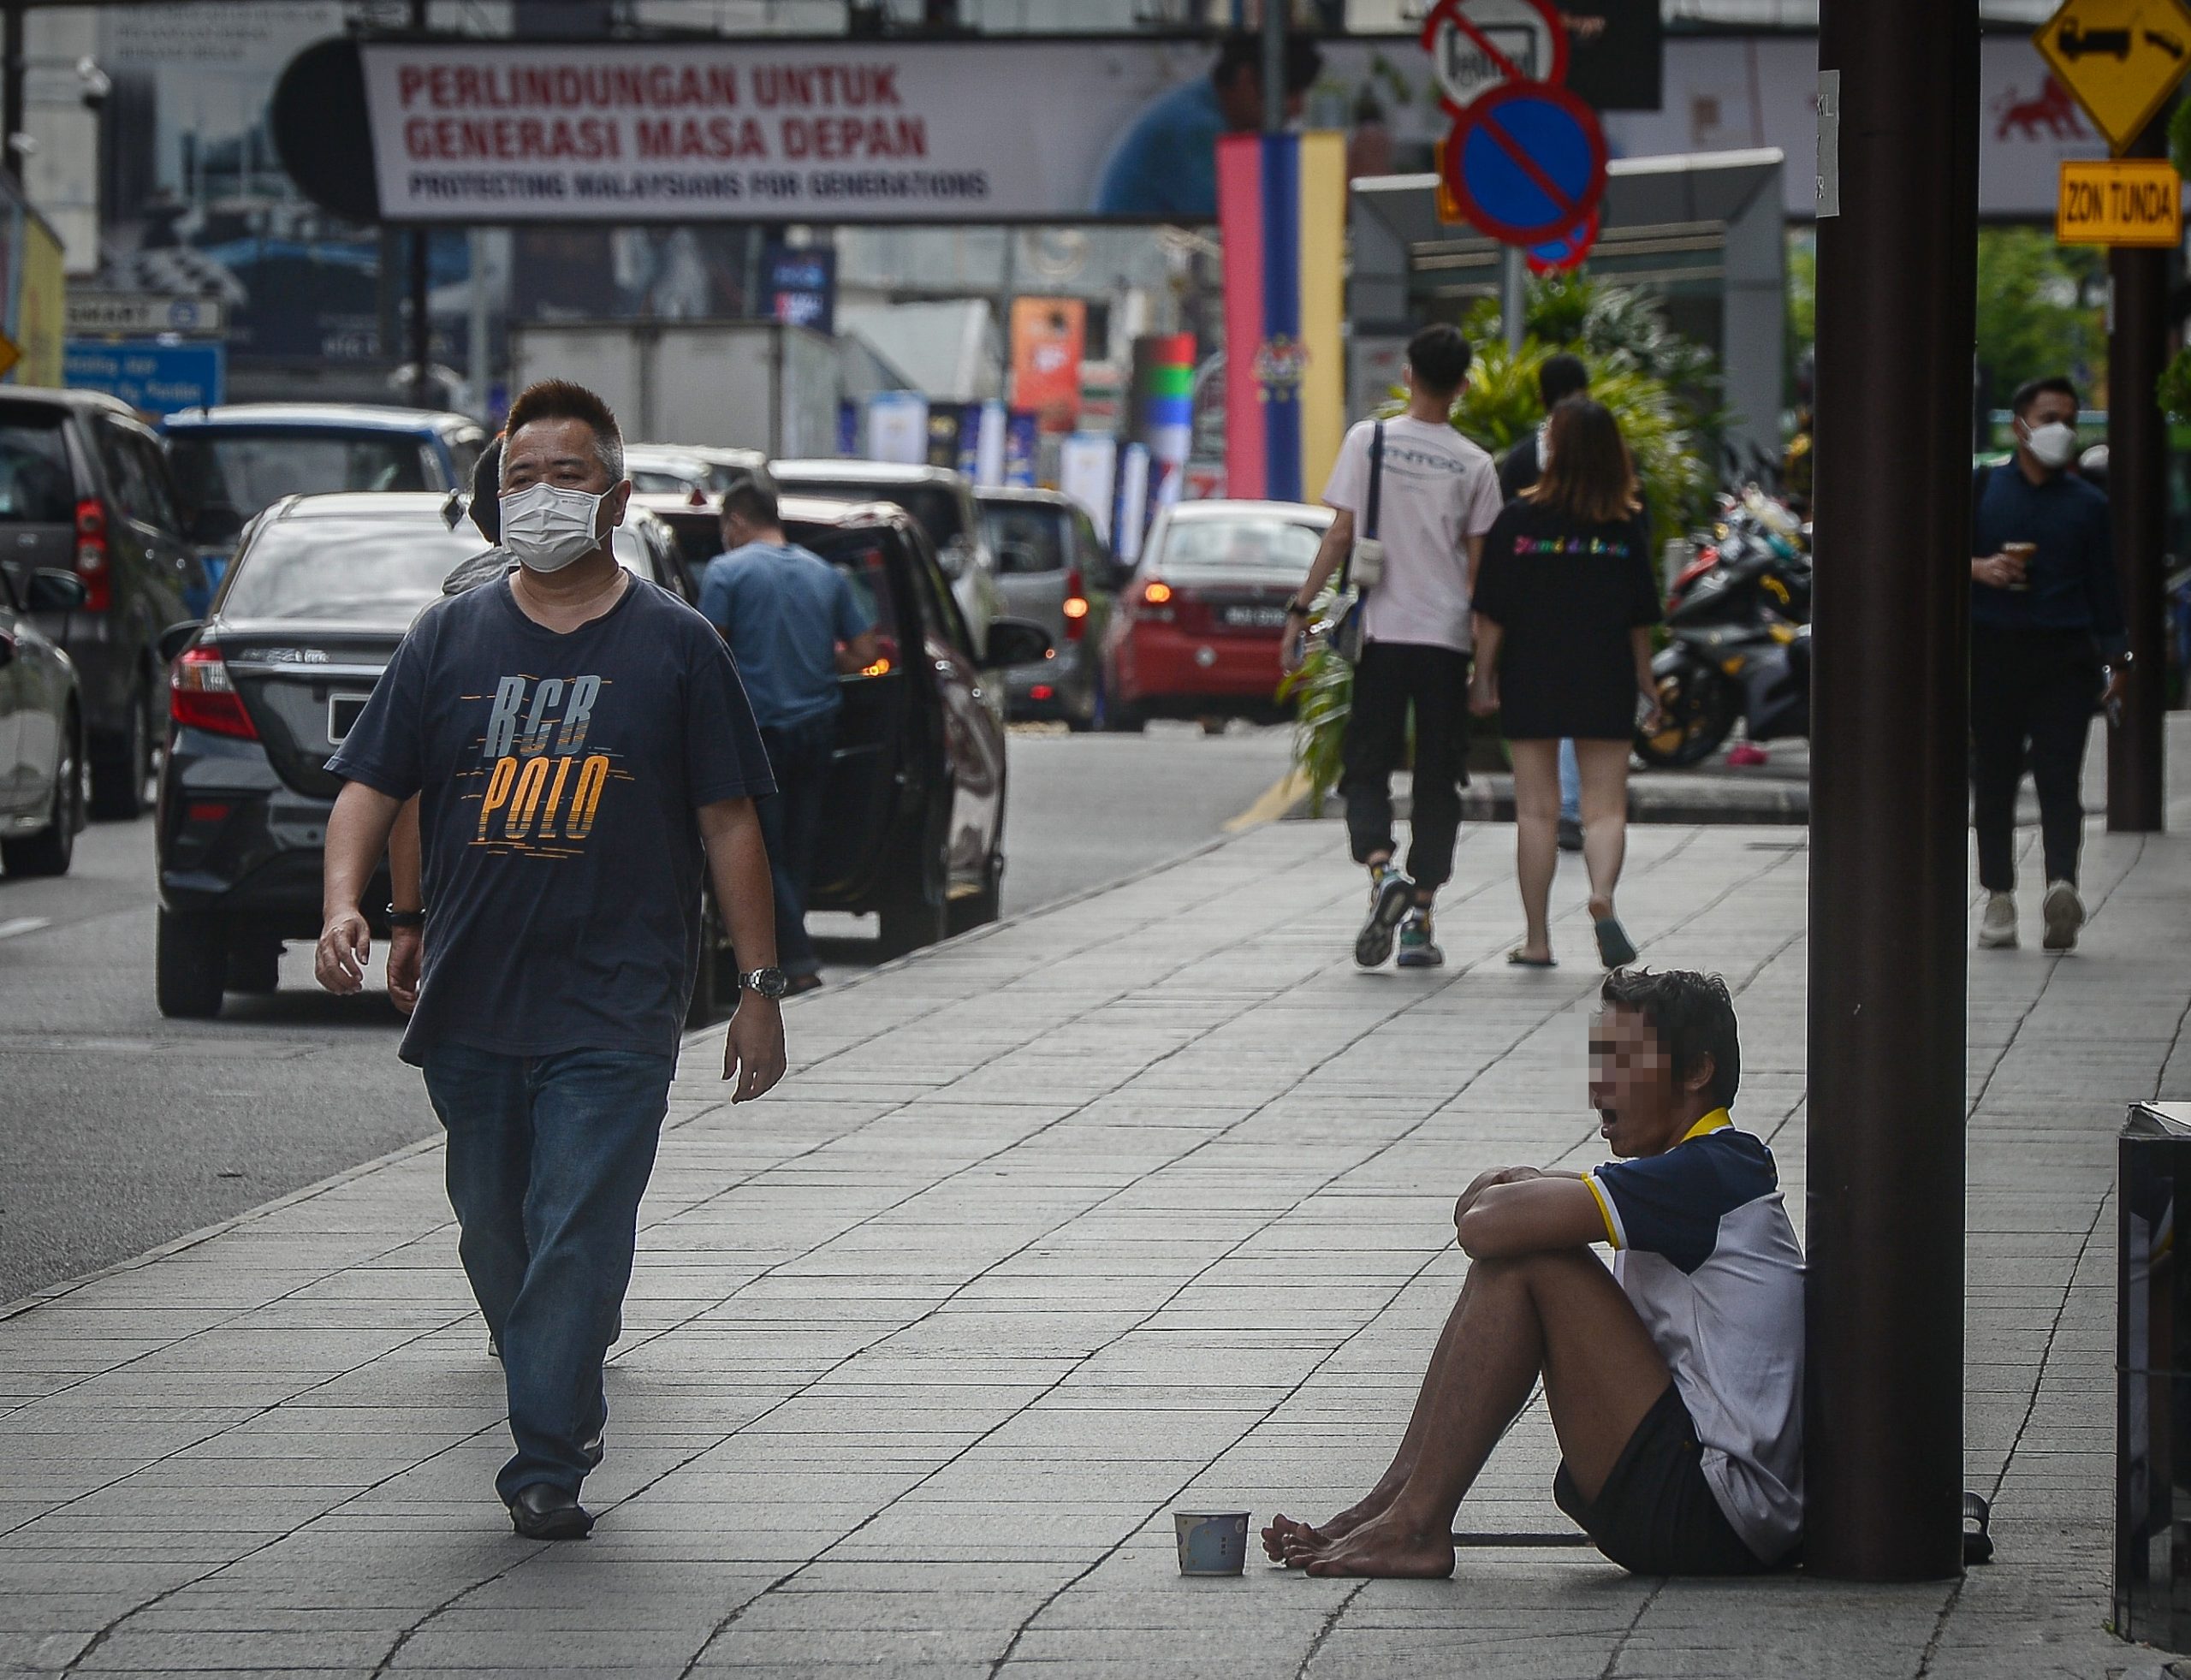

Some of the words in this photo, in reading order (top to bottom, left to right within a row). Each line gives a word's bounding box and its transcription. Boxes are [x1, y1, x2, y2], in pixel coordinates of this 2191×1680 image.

[400, 63, 737, 110] PERLINDUNGAN
[752, 62, 902, 108] UNTUK
[404, 117, 620, 161] GENERASI
[638, 116, 766, 160] MASA
[781, 116, 928, 159] DEPAN
[408, 172, 564, 199] PROTECTING
[573, 172, 741, 199] MALAYSIANS
[750, 172, 797, 198] FOR
[810, 170, 989, 199] GENERATIONS
[2066, 181, 2102, 223] ZON
[2111, 182, 2173, 223] TUNDA
[484, 675, 601, 757] RCB
[478, 755, 609, 841] POLO
